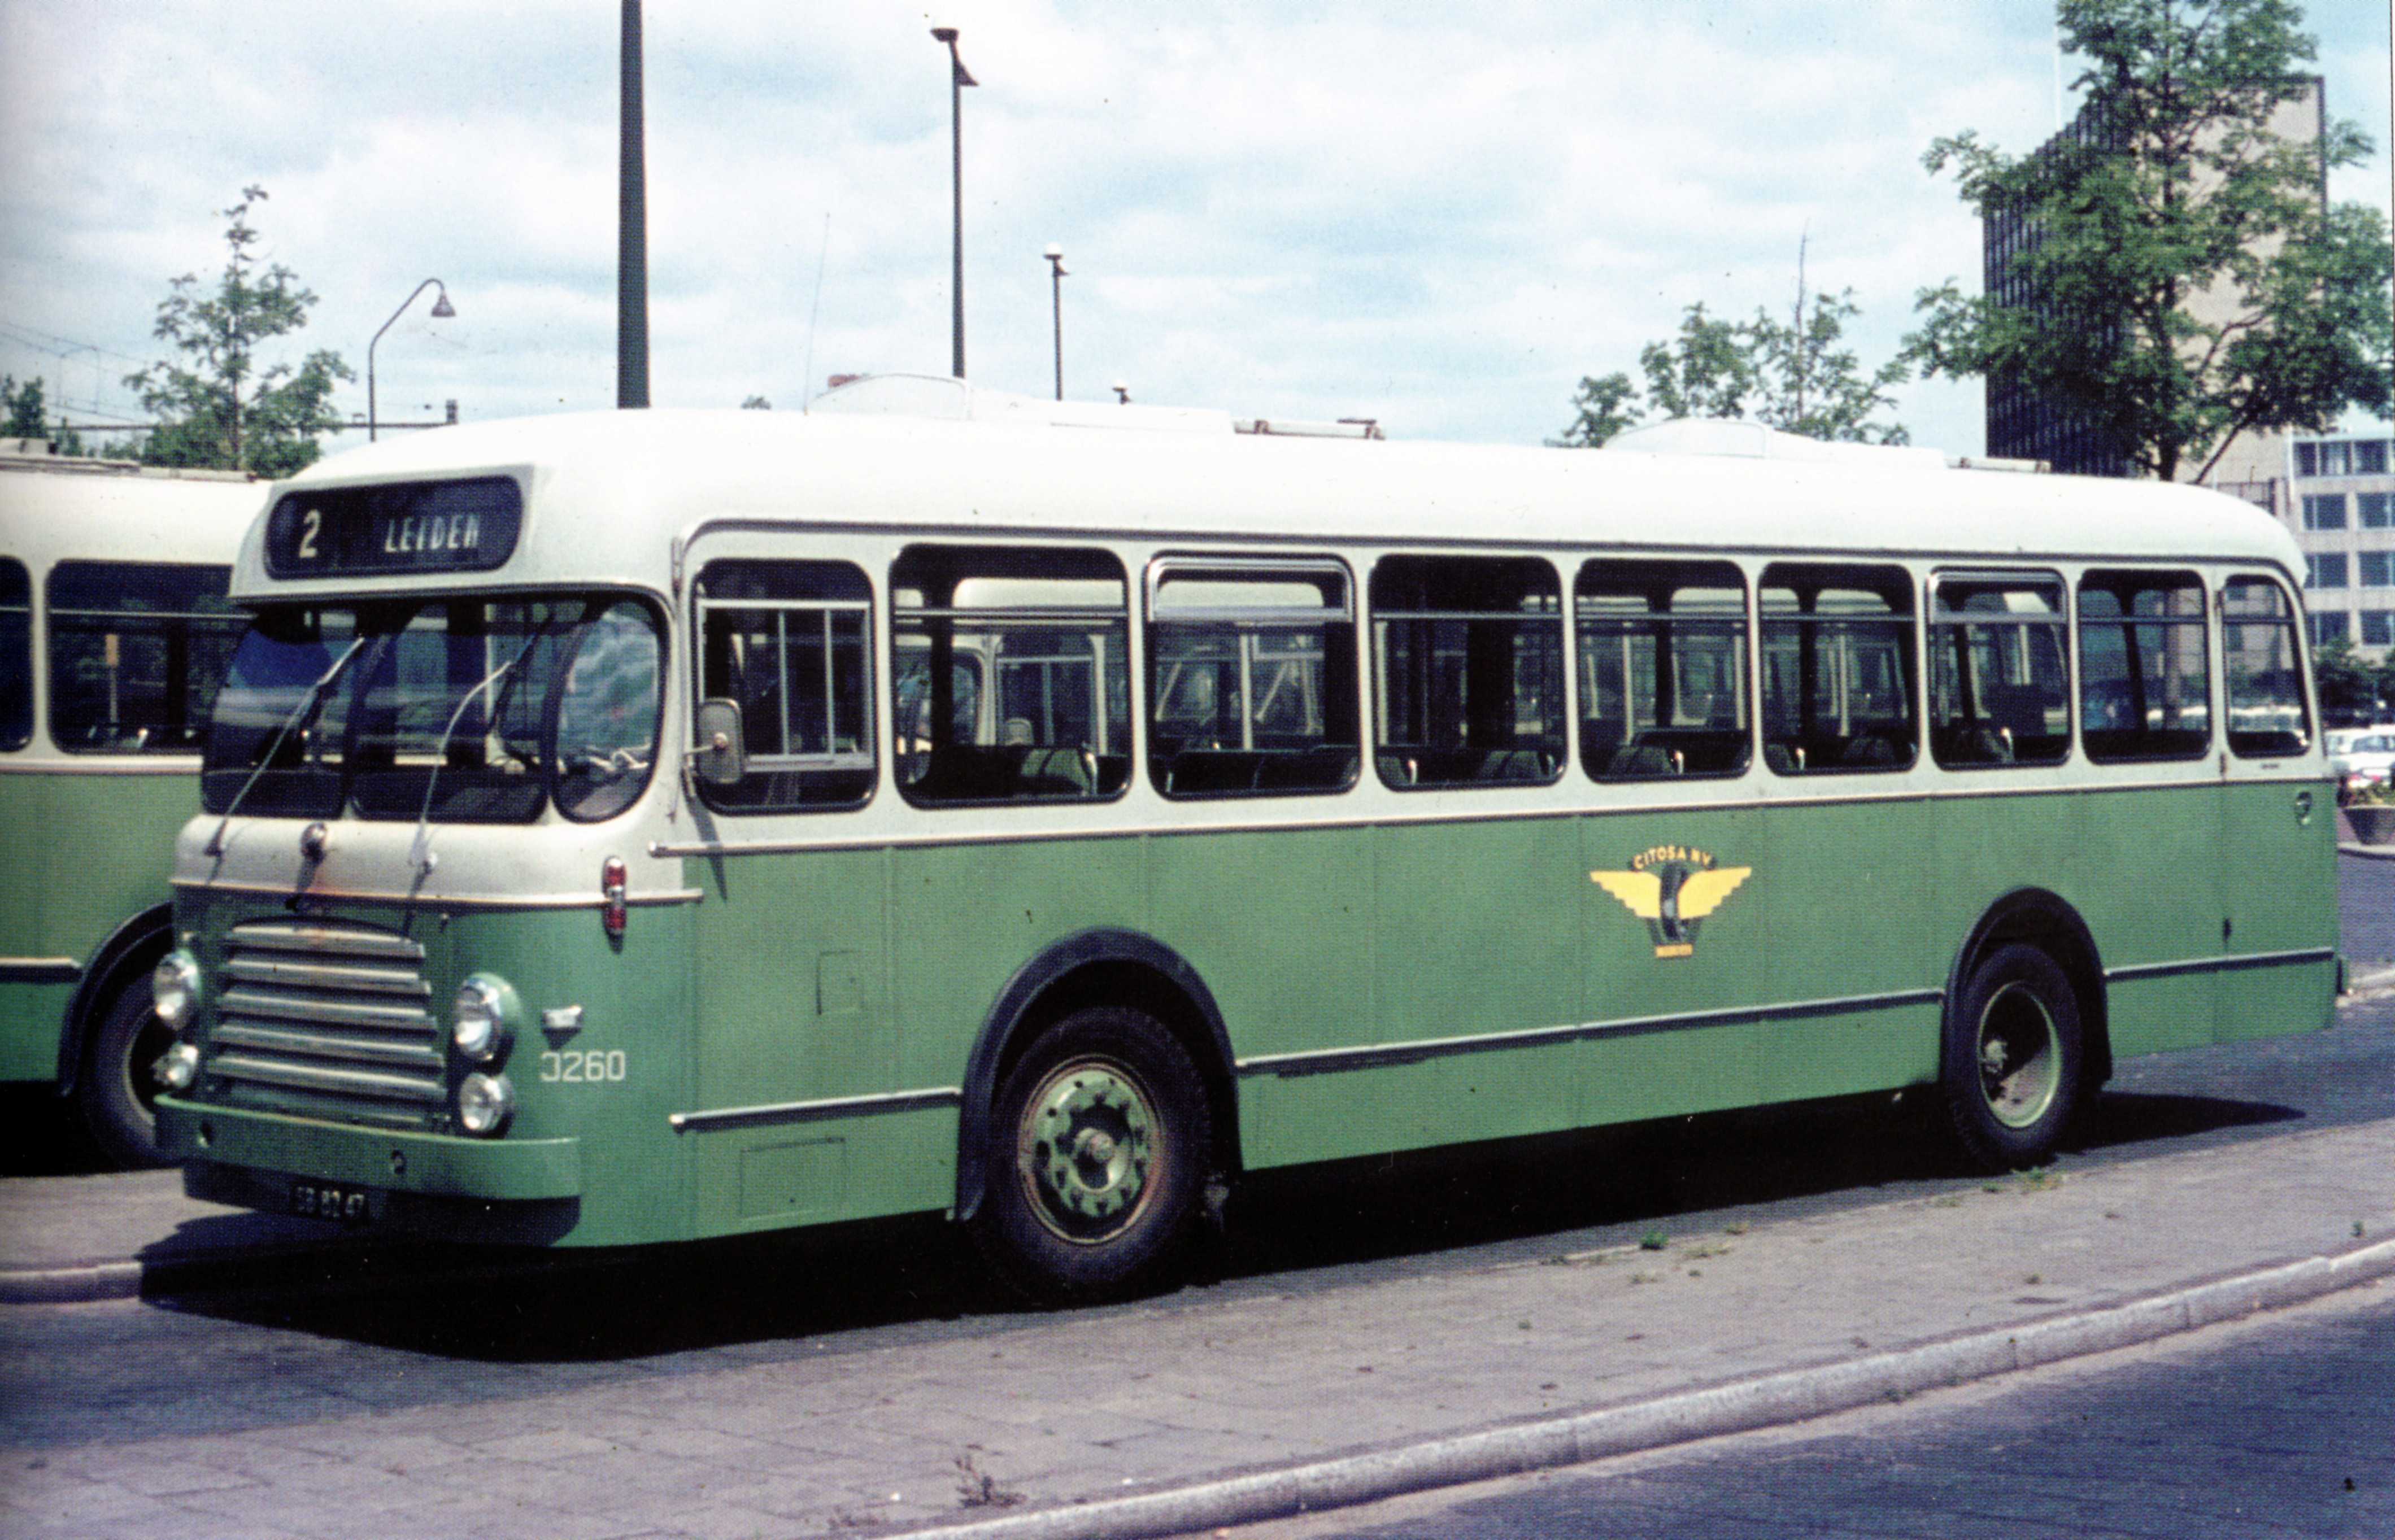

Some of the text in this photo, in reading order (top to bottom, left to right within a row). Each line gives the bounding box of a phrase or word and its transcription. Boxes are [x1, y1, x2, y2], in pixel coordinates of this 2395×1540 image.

[298, 508, 481, 559] 2 LEIDEN
[1633, 845, 1687, 870] CITOSA
